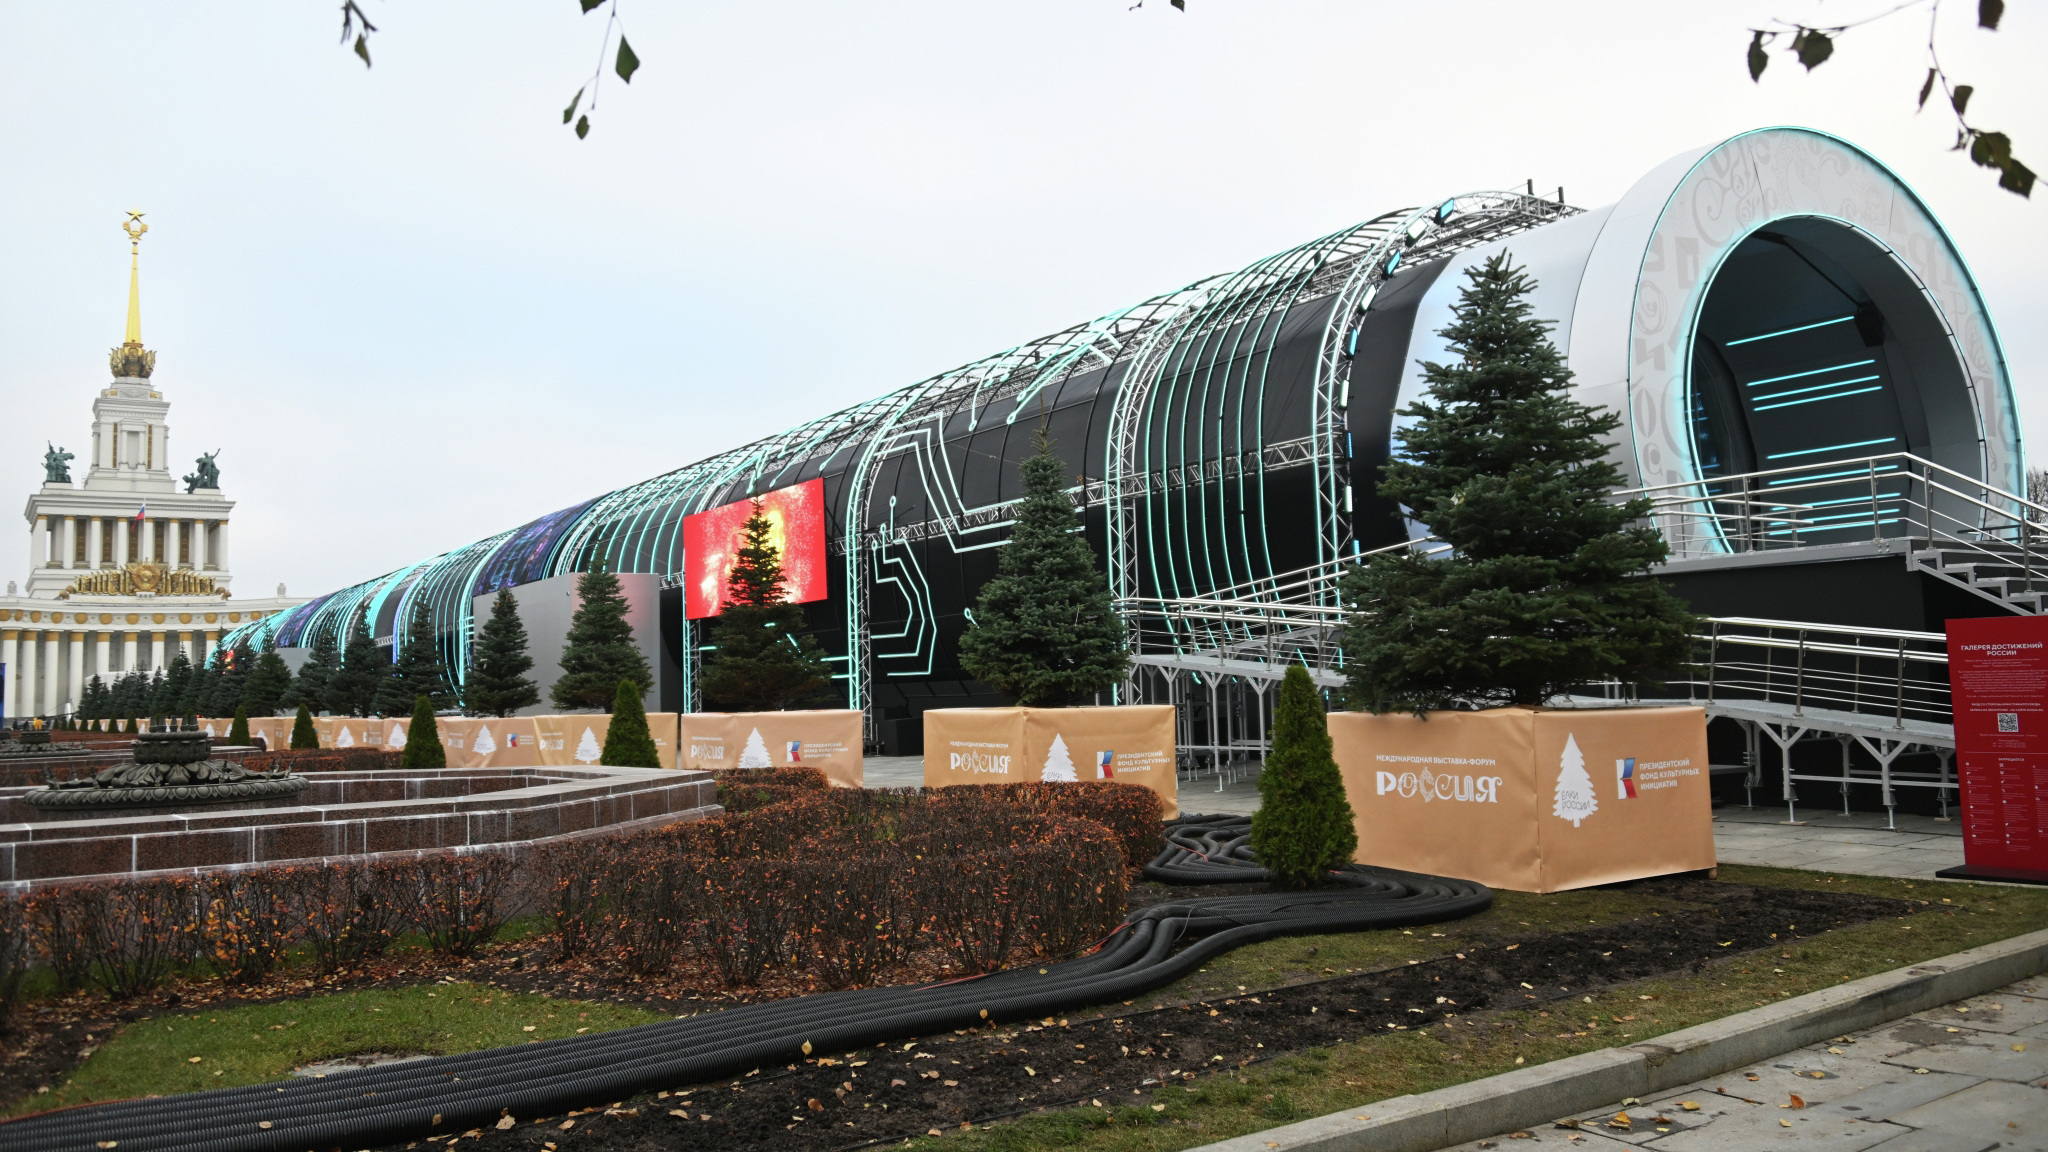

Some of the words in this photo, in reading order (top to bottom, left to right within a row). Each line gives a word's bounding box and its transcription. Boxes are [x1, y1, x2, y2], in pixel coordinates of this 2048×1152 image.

[1991, 642, 2043, 650] ДОСТИЖЕНИЙ
[1117, 751, 1163, 759] ПРЕЗИДЕНТСКИЙ
[1376, 755, 1432, 764] МЕЖДУНАРОДНАЯ
[1433, 757, 1496, 766] ВЫСТАВКА-ФОРУМ
[1639, 758, 1690, 770] ПРЕЗИДЕНТСКИЙ
[1640, 772, 1658, 780] ФОНД
[1660, 768, 1700, 779] КУЛЬТУРНЫХ
[1640, 780, 1678, 790] ИНИЦИАТИВ
